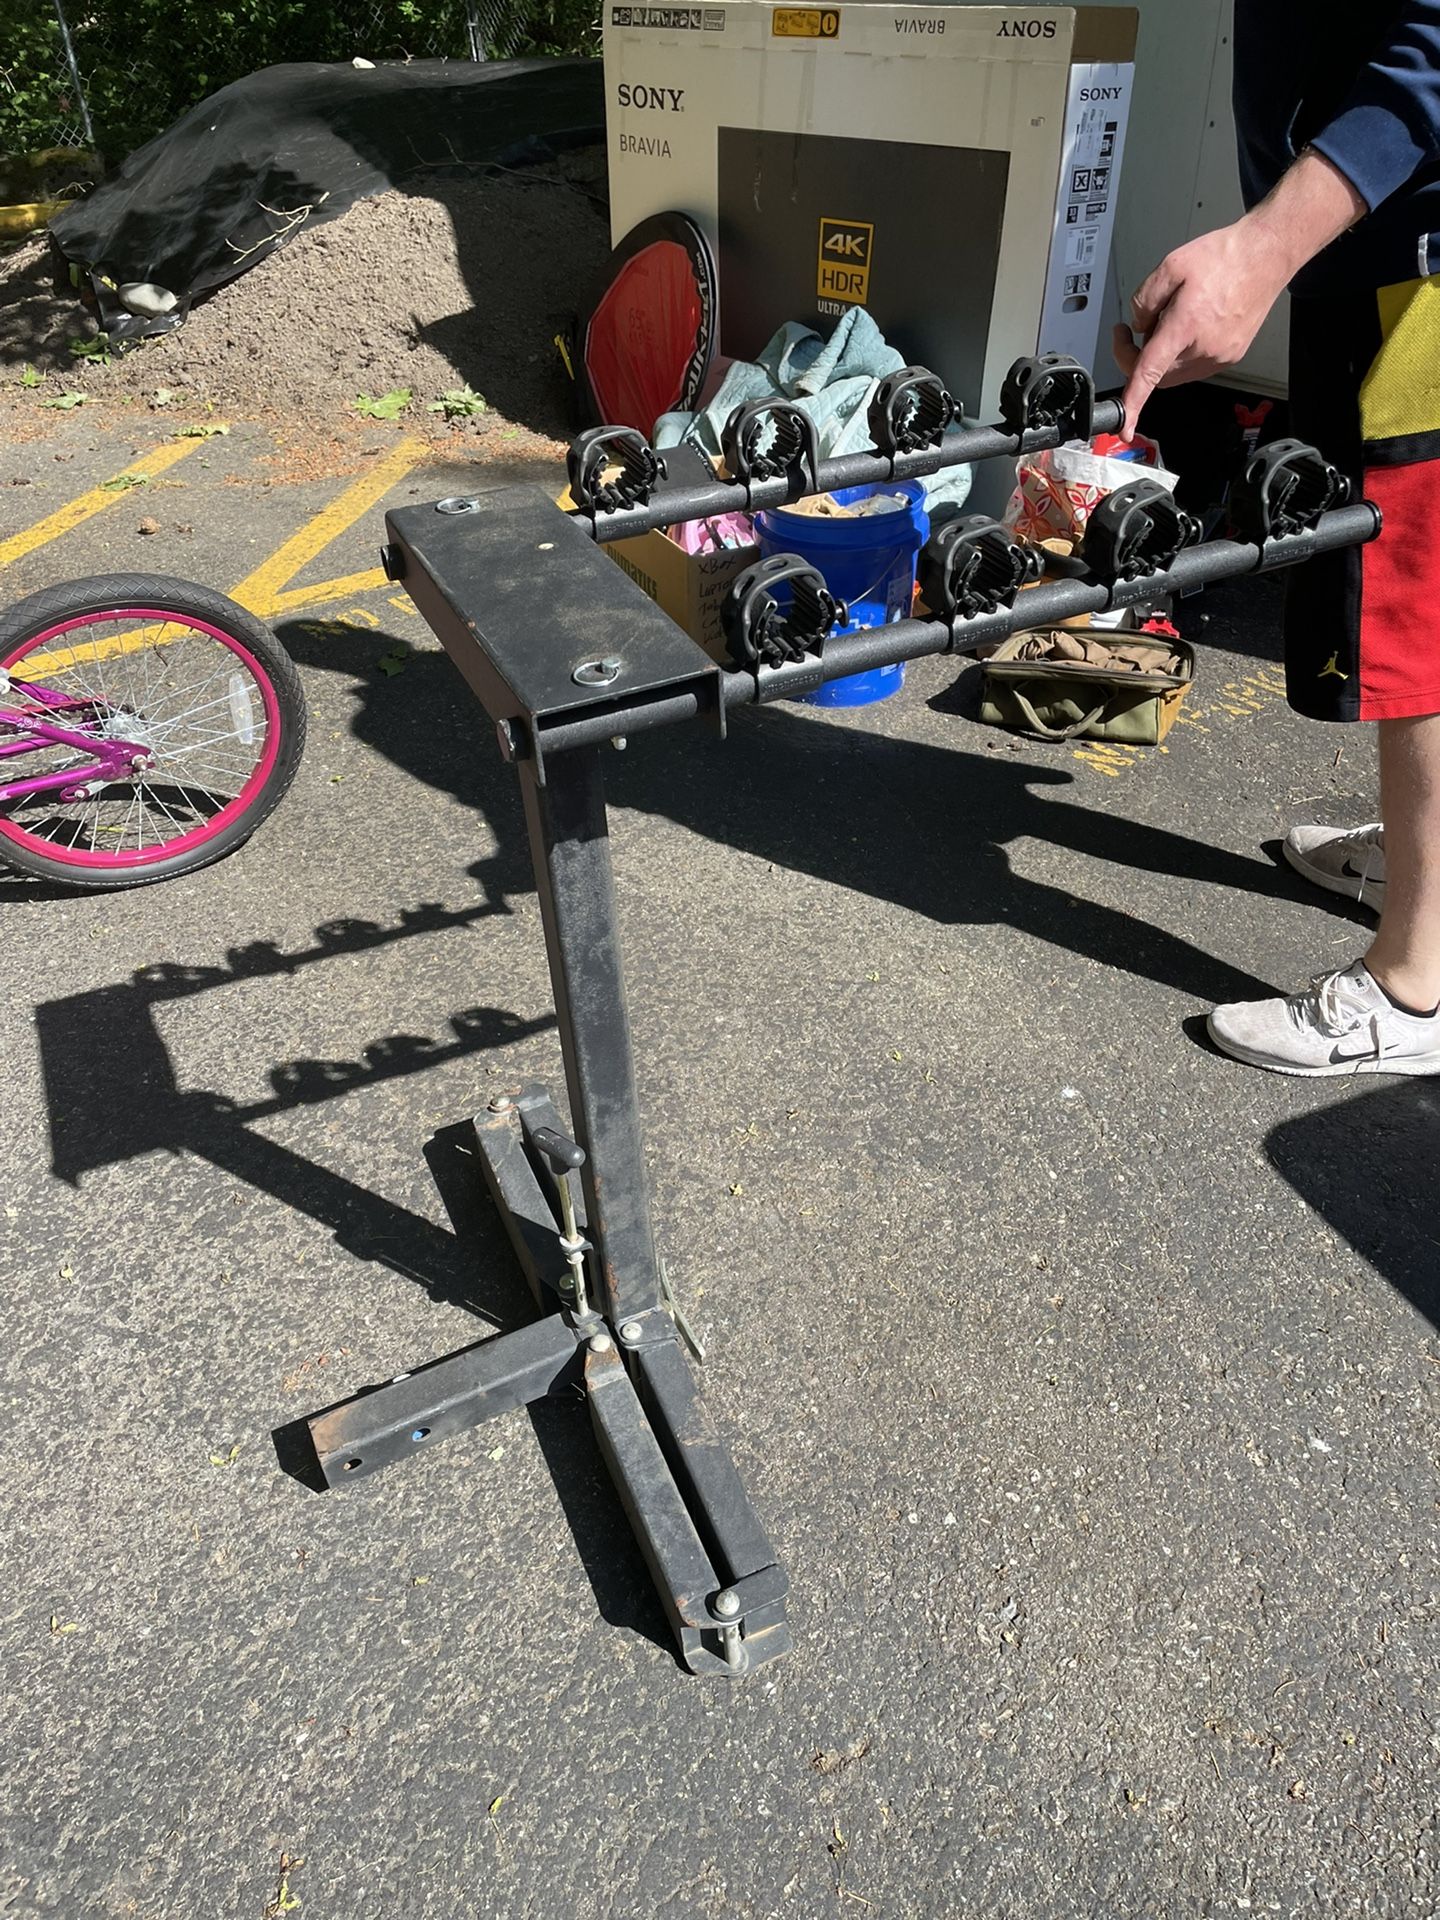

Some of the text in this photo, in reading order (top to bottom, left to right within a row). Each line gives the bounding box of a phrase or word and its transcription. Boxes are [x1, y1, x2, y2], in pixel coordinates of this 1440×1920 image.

[894, 19, 945, 34] BRAVIA
[996, 20, 1057, 38] SONY
[618, 83, 685, 112] SONY
[1080, 87, 1122, 101] SONY
[620, 133, 672, 159] BRAVIA
[824, 233, 867, 257] 4K
[822, 268, 864, 295] HDR
[817, 300, 847, 317] ULTRA
